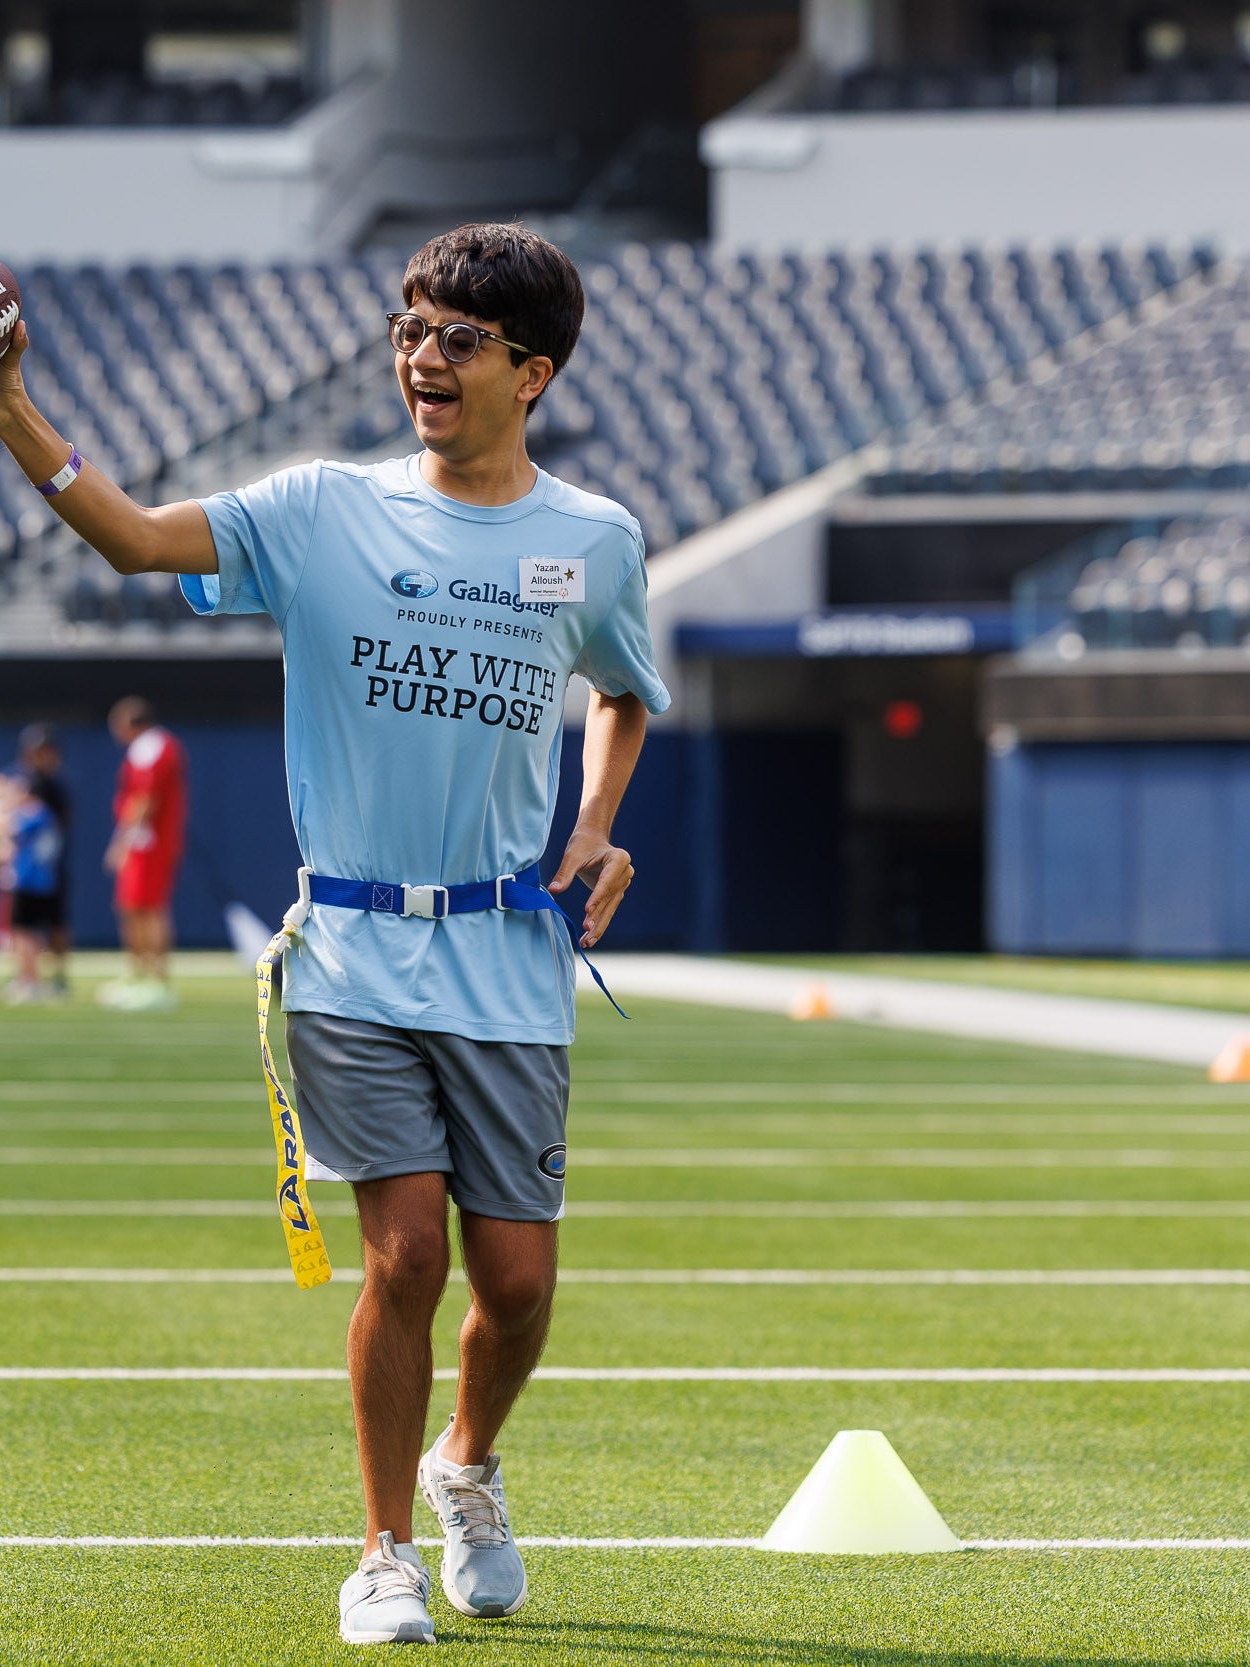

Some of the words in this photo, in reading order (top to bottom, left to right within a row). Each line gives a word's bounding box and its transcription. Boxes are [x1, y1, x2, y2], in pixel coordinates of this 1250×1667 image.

[531, 576, 563, 584] Alloush
[534, 563, 559, 572] Yazan
[397, 609, 467, 628] PROUDLY
[473, 619, 543, 644] PRESENTS
[350, 635, 458, 679] PLAY
[470, 652, 557, 703] WITH
[365, 675, 544, 735] PURPOSE
[279, 1174, 311, 1232] LA
